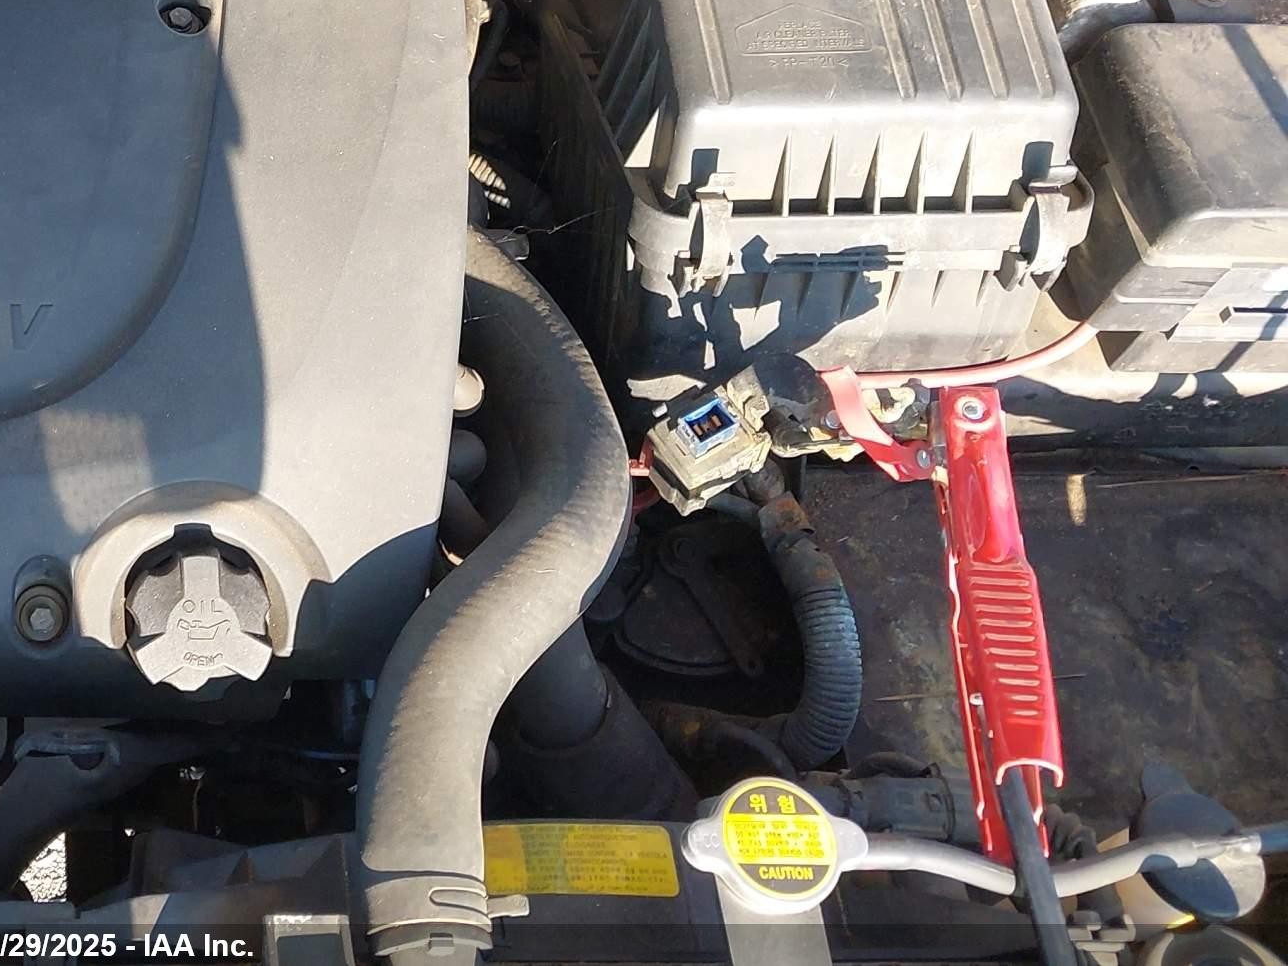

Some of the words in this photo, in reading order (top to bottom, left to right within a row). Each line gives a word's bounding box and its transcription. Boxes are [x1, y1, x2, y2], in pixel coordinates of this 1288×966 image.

[181, 598, 225, 615] OIL
[182, 651, 216, 667] OPEN
[758, 865, 814, 881] CAUTION
